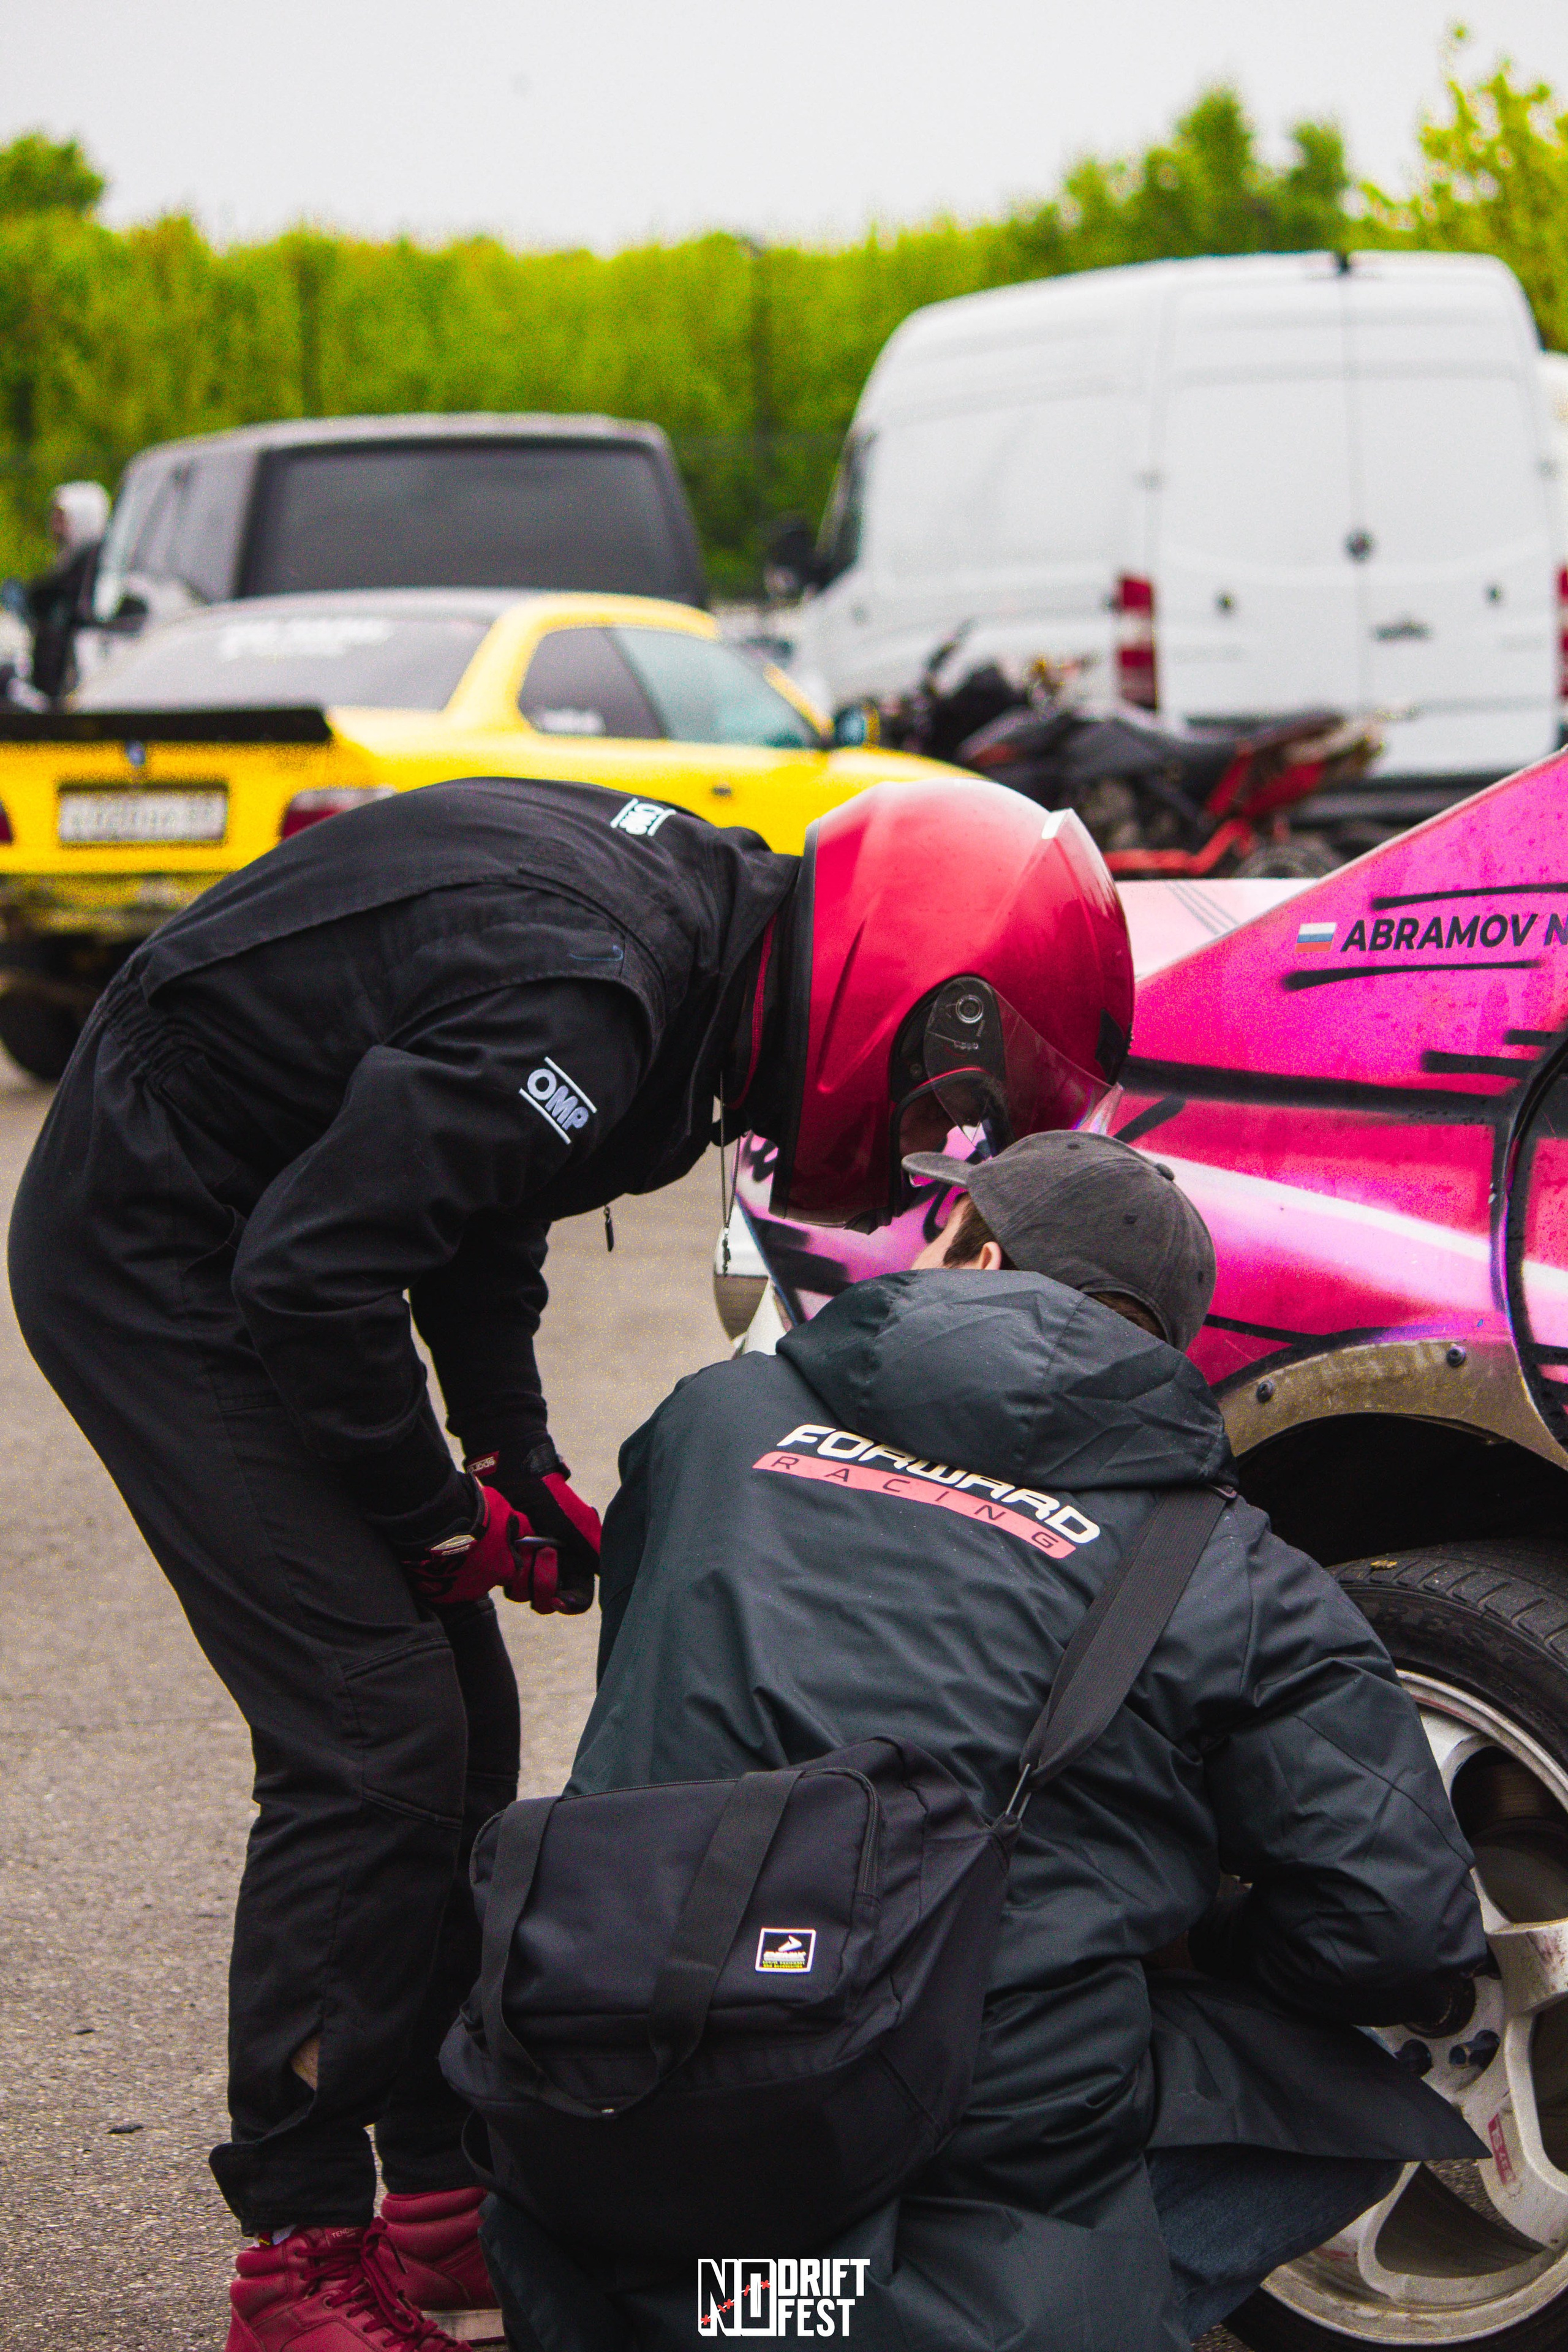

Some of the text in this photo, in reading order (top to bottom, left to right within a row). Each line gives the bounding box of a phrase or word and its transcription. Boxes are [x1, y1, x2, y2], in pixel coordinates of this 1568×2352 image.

[1340, 913, 1538, 952] ABRAMOV
[527, 1068, 589, 1130] OMP
[771, 1457, 1059, 1549] RACING
[777, 1424, 1101, 1544] FORWARD
